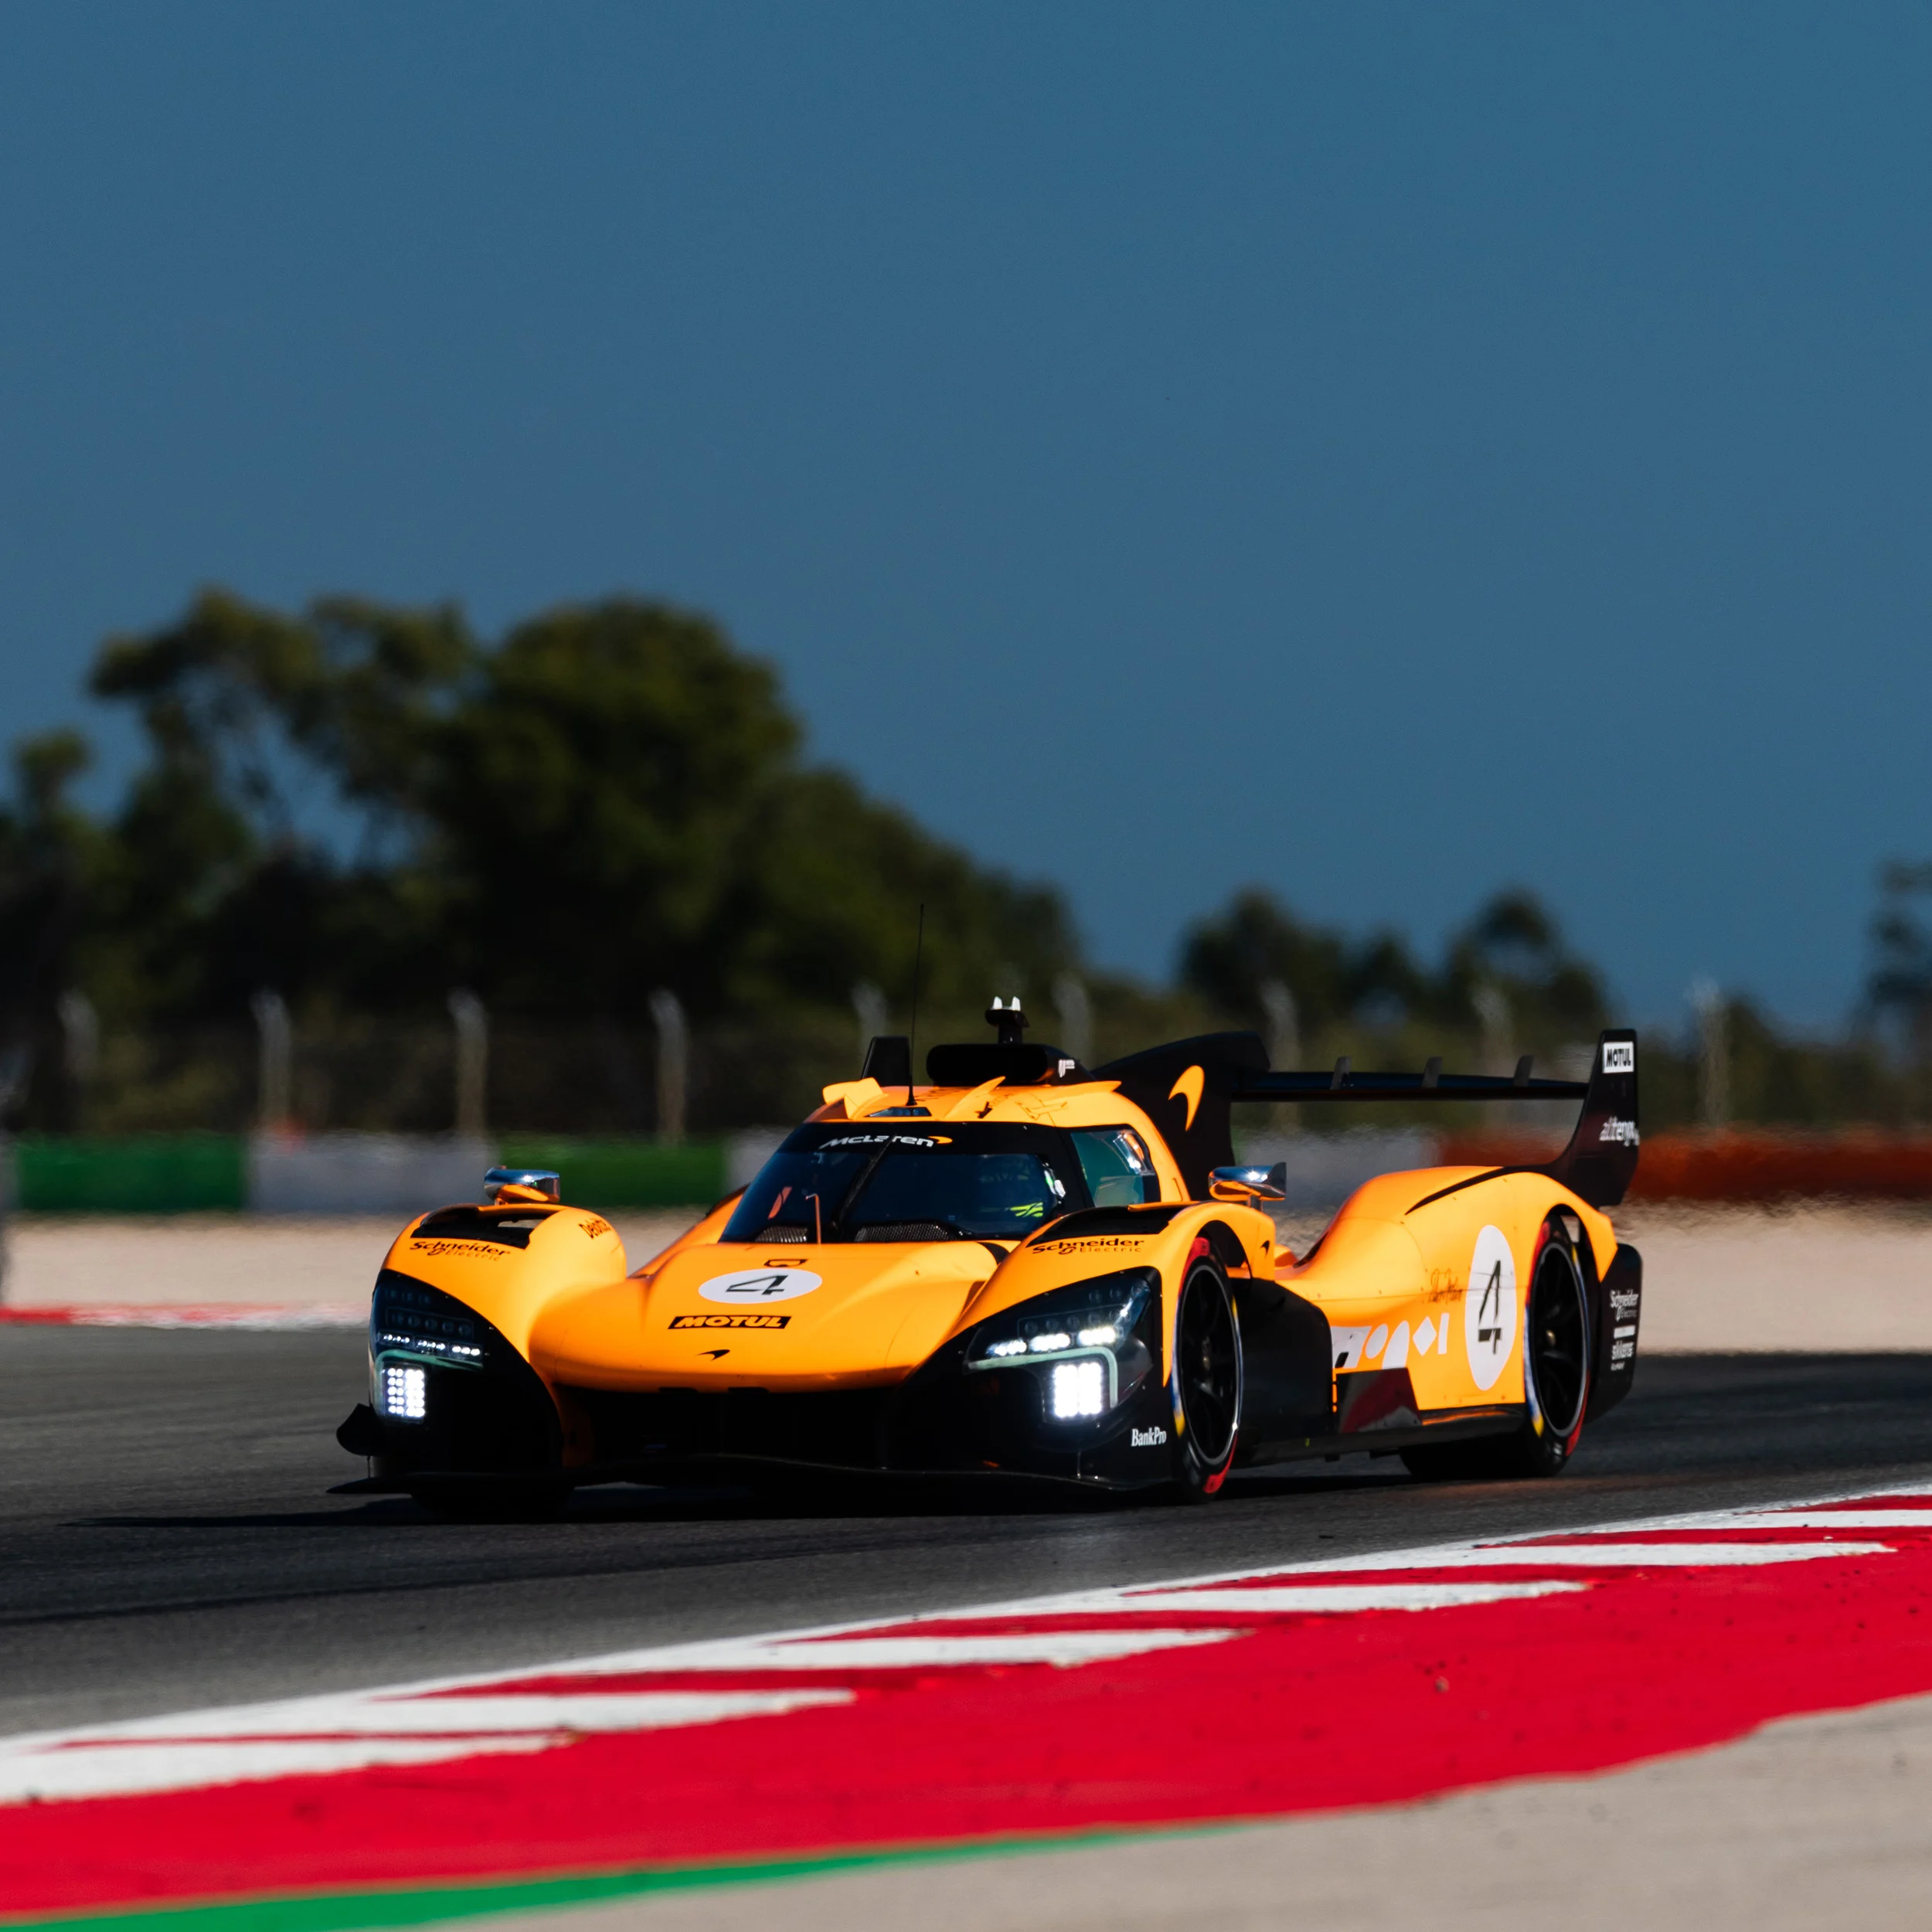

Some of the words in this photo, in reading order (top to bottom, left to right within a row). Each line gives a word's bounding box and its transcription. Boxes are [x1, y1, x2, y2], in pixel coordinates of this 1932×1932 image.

[1606, 1049, 1631, 1067] MOTUL
[818, 1135, 934, 1150] McLaren
[410, 1241, 511, 1256] Schneider
[1032, 1238, 1145, 1253] Schneider
[725, 1274, 789, 1296] 4
[1478, 1260, 1502, 1355] 4
[673, 1315, 783, 1328] MOTUL
[1131, 1426, 1168, 1447] BankPro
